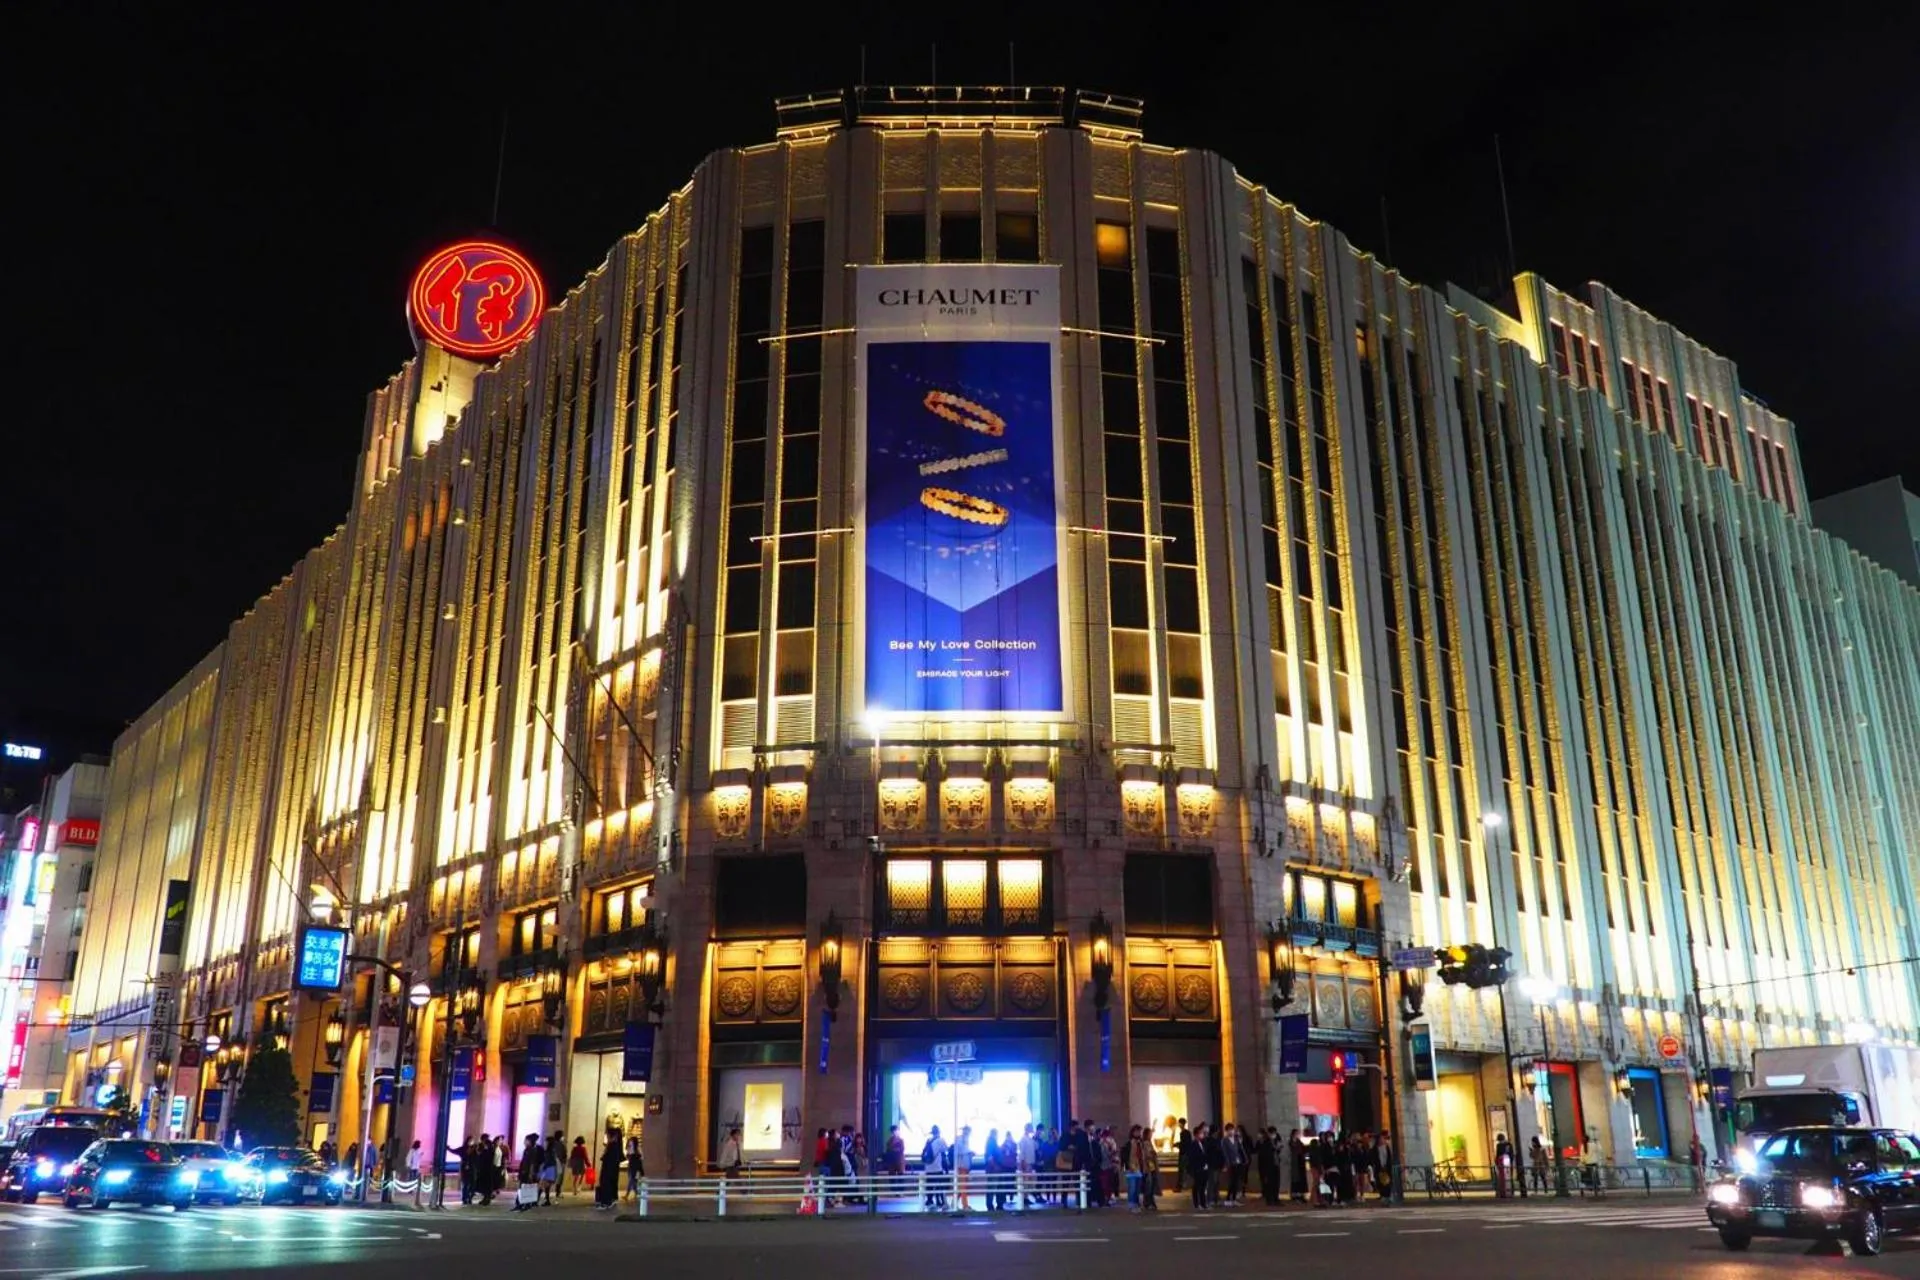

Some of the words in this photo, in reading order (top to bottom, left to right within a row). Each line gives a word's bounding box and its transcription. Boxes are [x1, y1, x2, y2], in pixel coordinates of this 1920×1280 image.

[878, 288, 1039, 306] CHAUMET
[939, 307, 977, 316] PARIS
[889, 640, 914, 650] Bee
[918, 640, 936, 652] My
[941, 640, 970, 650] Love
[974, 639, 1037, 650] Collection
[916, 670, 958, 678] EMBRACE
[960, 670, 983, 678] YOUR
[985, 670, 1010, 678] LIGHT
